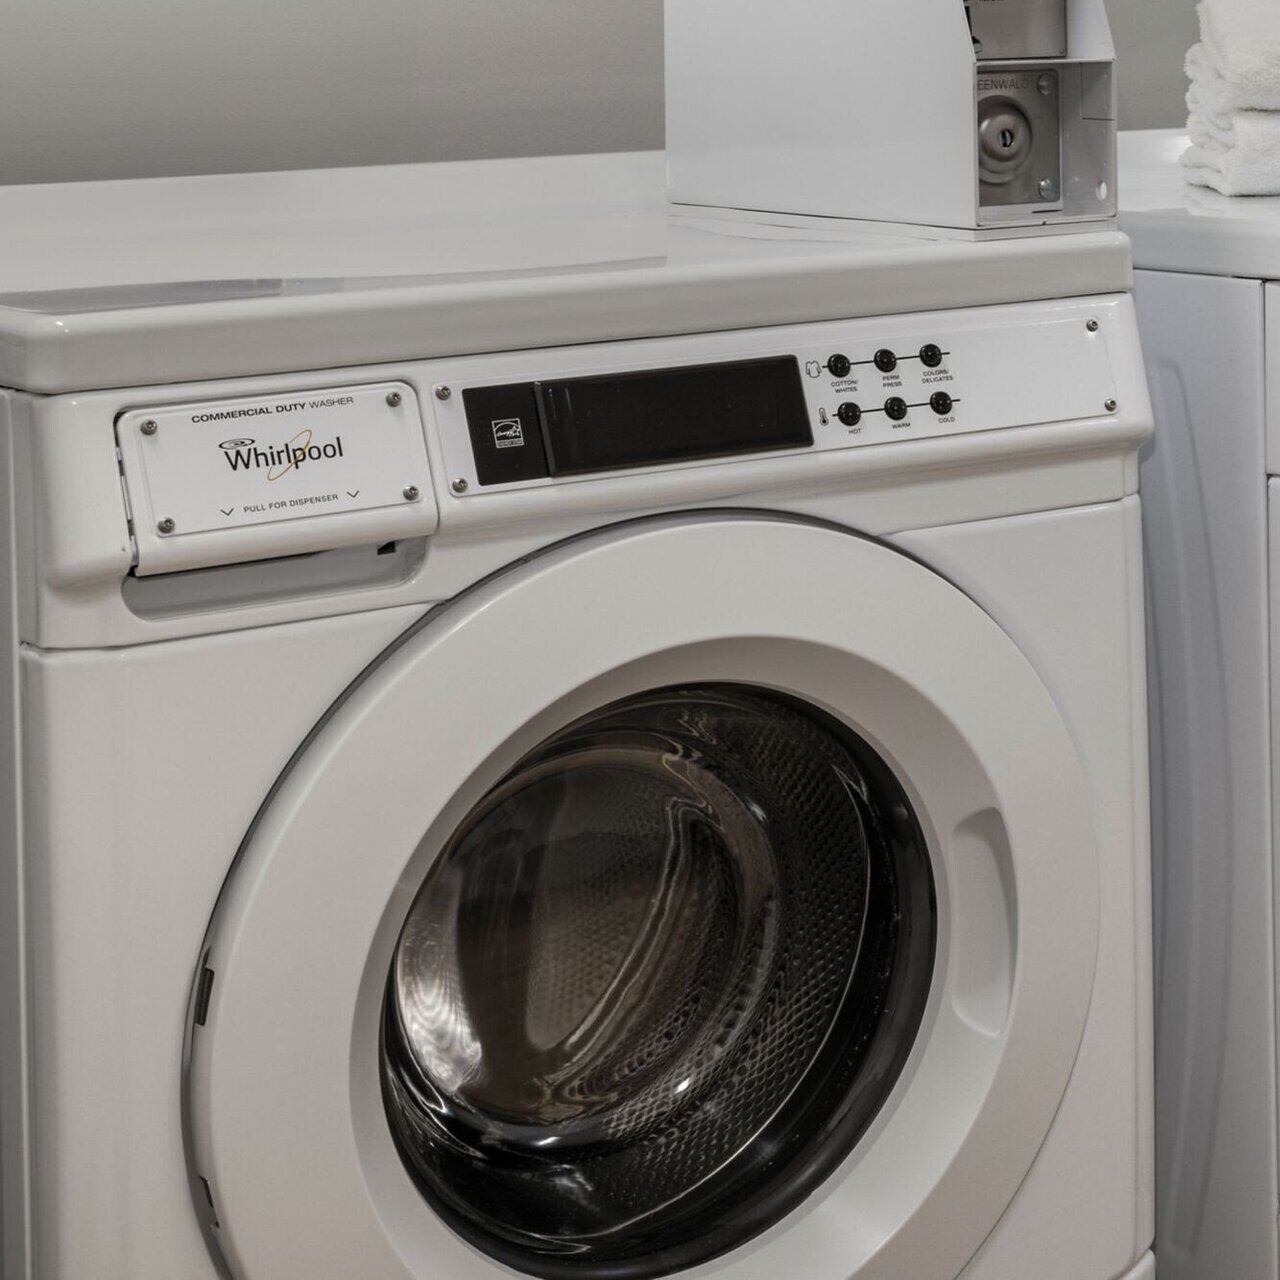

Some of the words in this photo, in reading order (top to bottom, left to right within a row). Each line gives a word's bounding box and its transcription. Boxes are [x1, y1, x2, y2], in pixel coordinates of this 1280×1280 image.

[977, 78, 1029, 90] EENWALD
[921, 375, 954, 384] DELICATES
[834, 386, 858, 394] WHITES
[192, 407, 273, 423] COMMERCIAL
[275, 402, 307, 414] DUTY
[308, 397, 354, 409] WASHER
[224, 436, 343, 471] Whirlpool
[243, 505, 267, 513] PULL
[269, 501, 287, 510] FOR
[289, 494, 339, 507] DISPENSER
